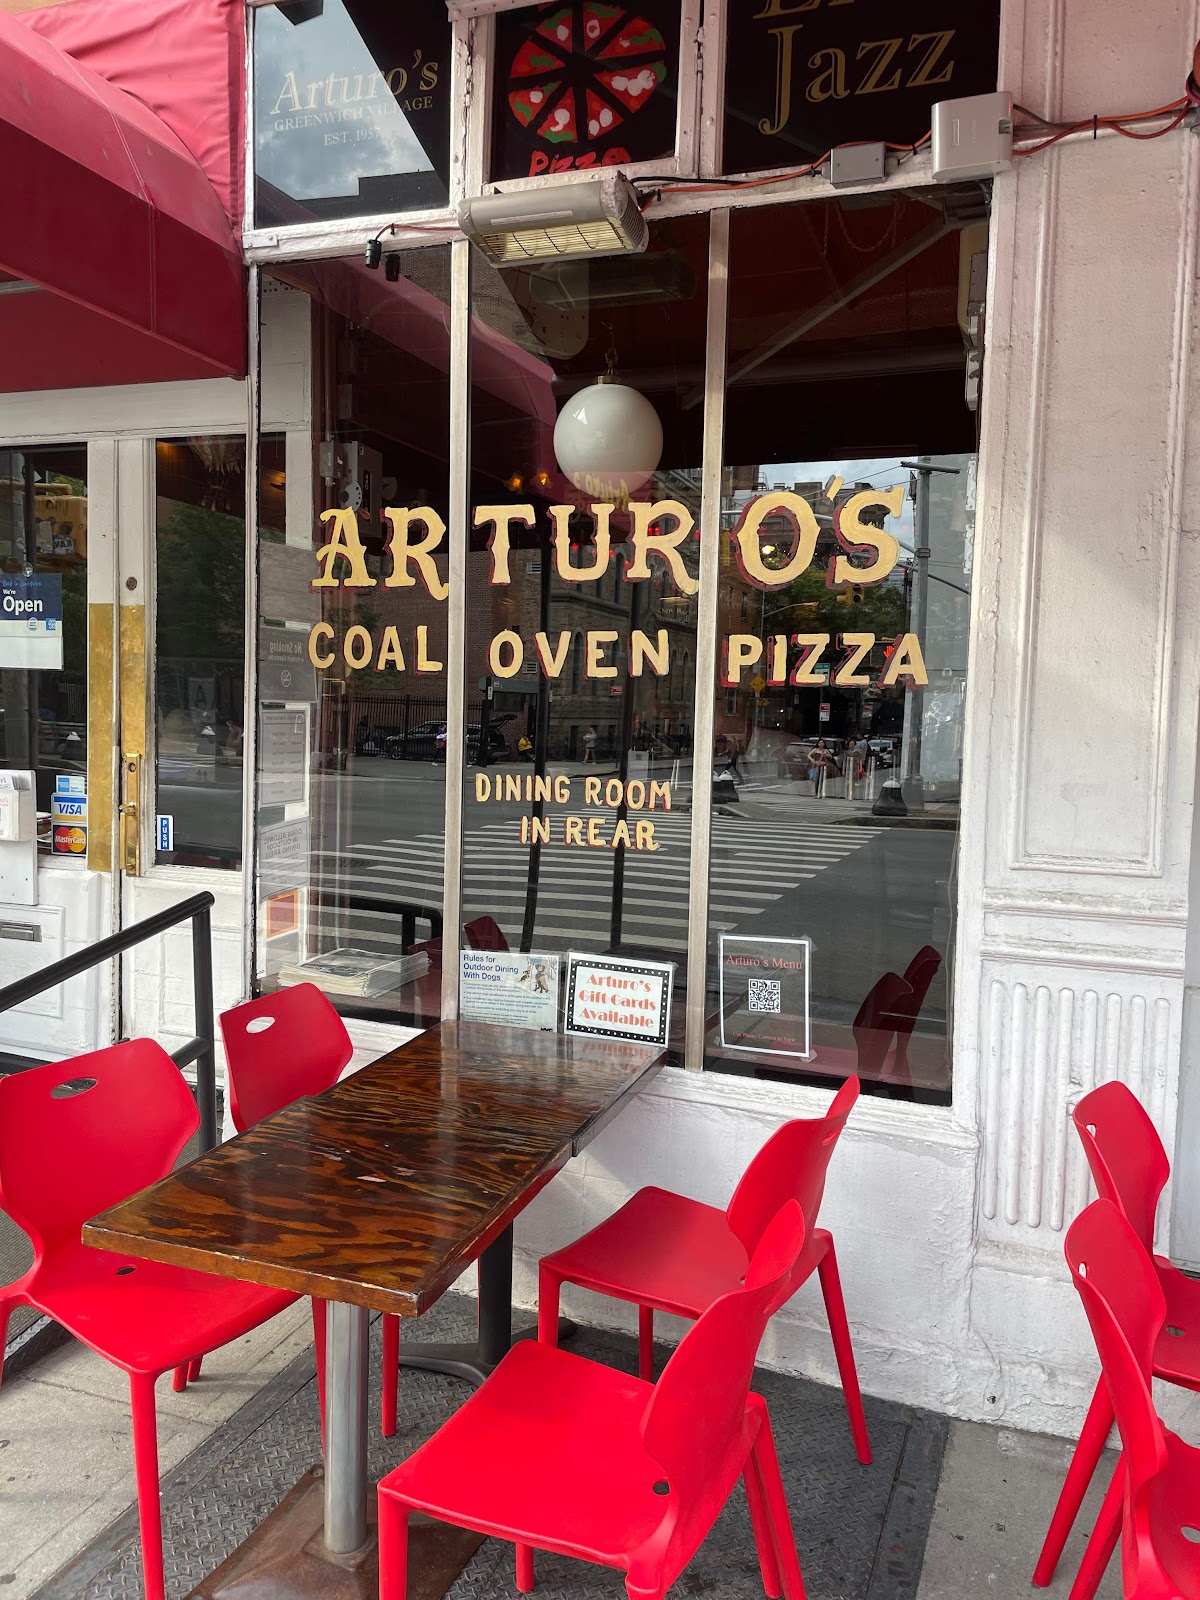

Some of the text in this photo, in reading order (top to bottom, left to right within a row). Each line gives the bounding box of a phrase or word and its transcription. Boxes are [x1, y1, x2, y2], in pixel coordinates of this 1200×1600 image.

[269, 49, 439, 115] Arturo's
[758, 24, 956, 135] Jazz
[274, 96, 433, 131] GREENWICH VILLAGE
[323, 131, 352, 146] EST.
[528, 147, 631, 177] Pizza
[309, 475, 904, 600] ARTURO'S
[3, 595, 43, 616] Open
[308, 621, 929, 690] COAL OVEN PIZZA
[475, 773, 672, 812] DINING ROOM
[58, 803, 82, 815] VISA
[54, 835, 86, 845] MasterCard
[519, 815, 662, 851] IN REAR
[463, 954, 496, 963] Rules for
[463, 962, 519, 974] Outdoor Dining
[726, 954, 803, 970] Arturo's Menu
[463, 971, 501, 981] With Dogs
[586, 974, 651, 993] Arturo's
[579, 989, 656, 1011] Gift Cards
[579, 1007, 654, 1028] Available
